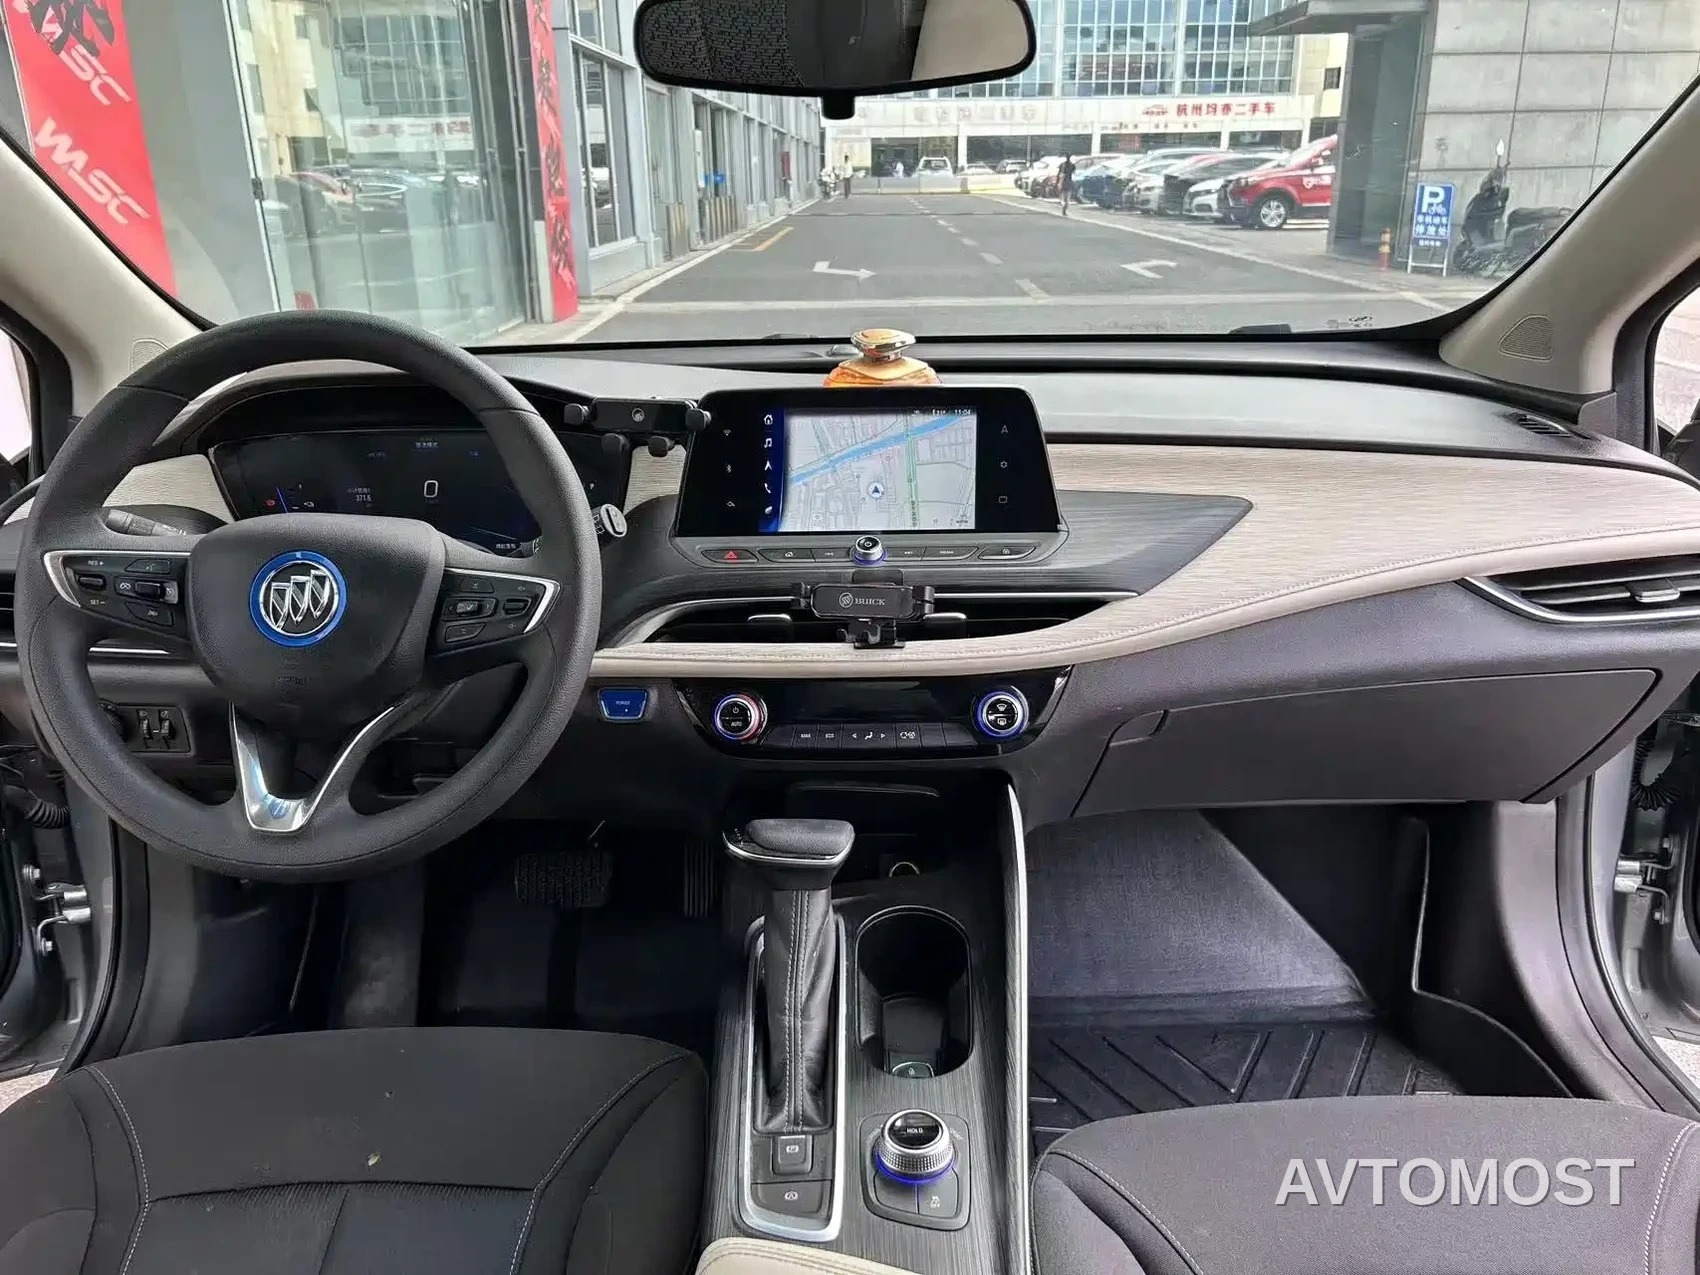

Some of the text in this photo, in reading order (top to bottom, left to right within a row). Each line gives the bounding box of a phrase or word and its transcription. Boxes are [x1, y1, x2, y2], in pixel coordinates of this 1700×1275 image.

[1421, 185, 1445, 213] P
[424, 480, 439, 498] 0
[855, 597, 886, 606] BUICK
